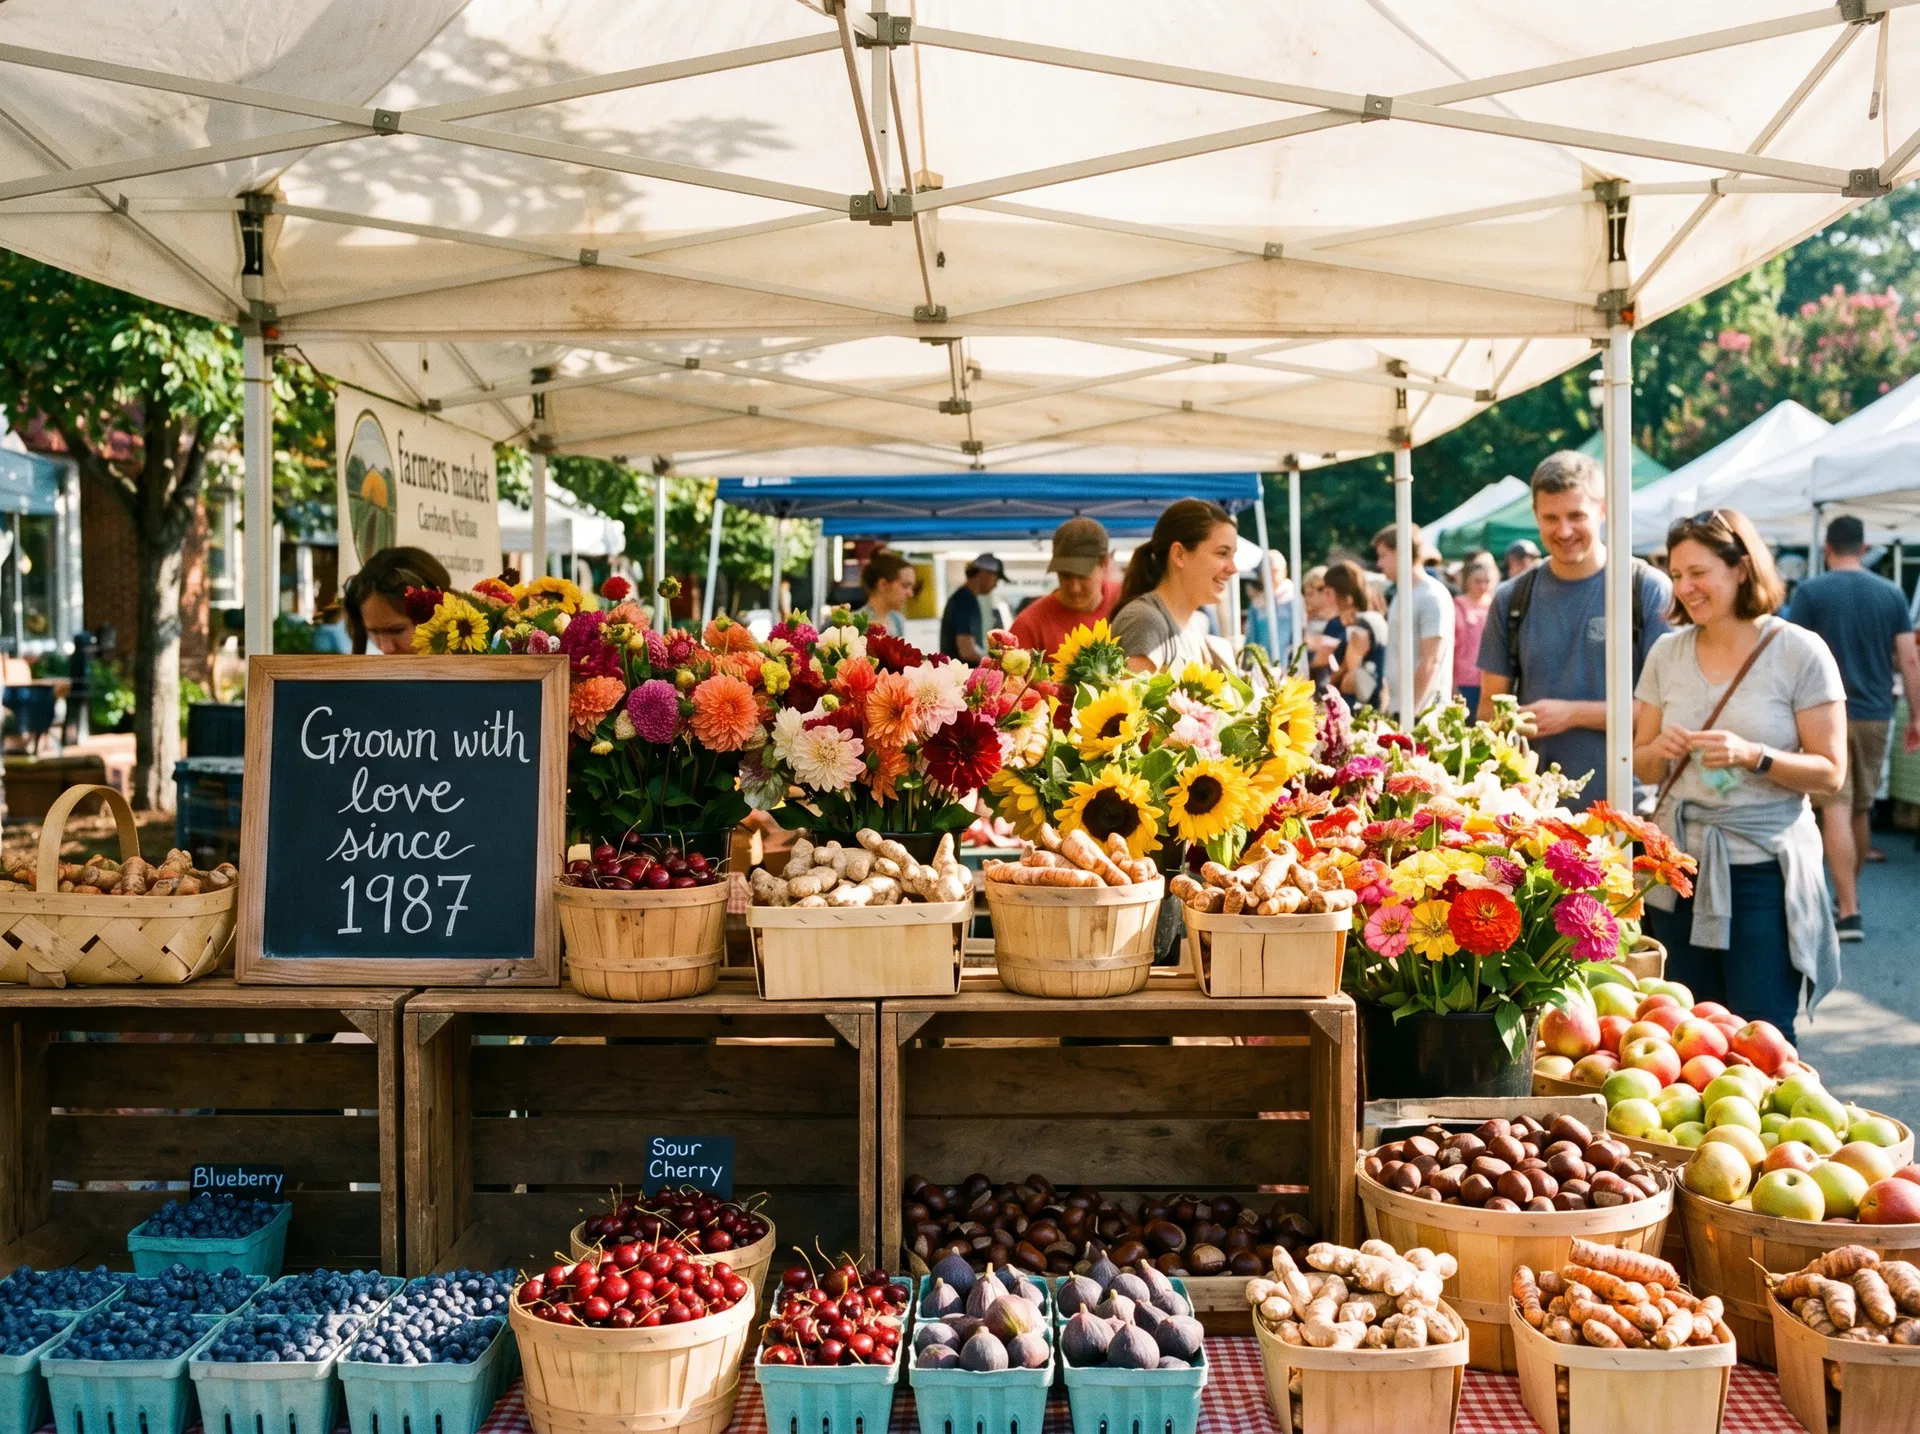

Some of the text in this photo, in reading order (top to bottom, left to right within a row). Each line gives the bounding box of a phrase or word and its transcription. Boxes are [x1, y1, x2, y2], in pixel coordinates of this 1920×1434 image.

[451, 452, 490, 503] market
[300, 705, 531, 765] Grown with
[337, 766, 466, 814] love
[325, 822, 476, 862] since
[336, 873, 473, 937] 1987
[652, 1137, 703, 1157] Sour
[192, 1166, 284, 1194] Blueberry
[649, 1159, 723, 1187] Cherry
